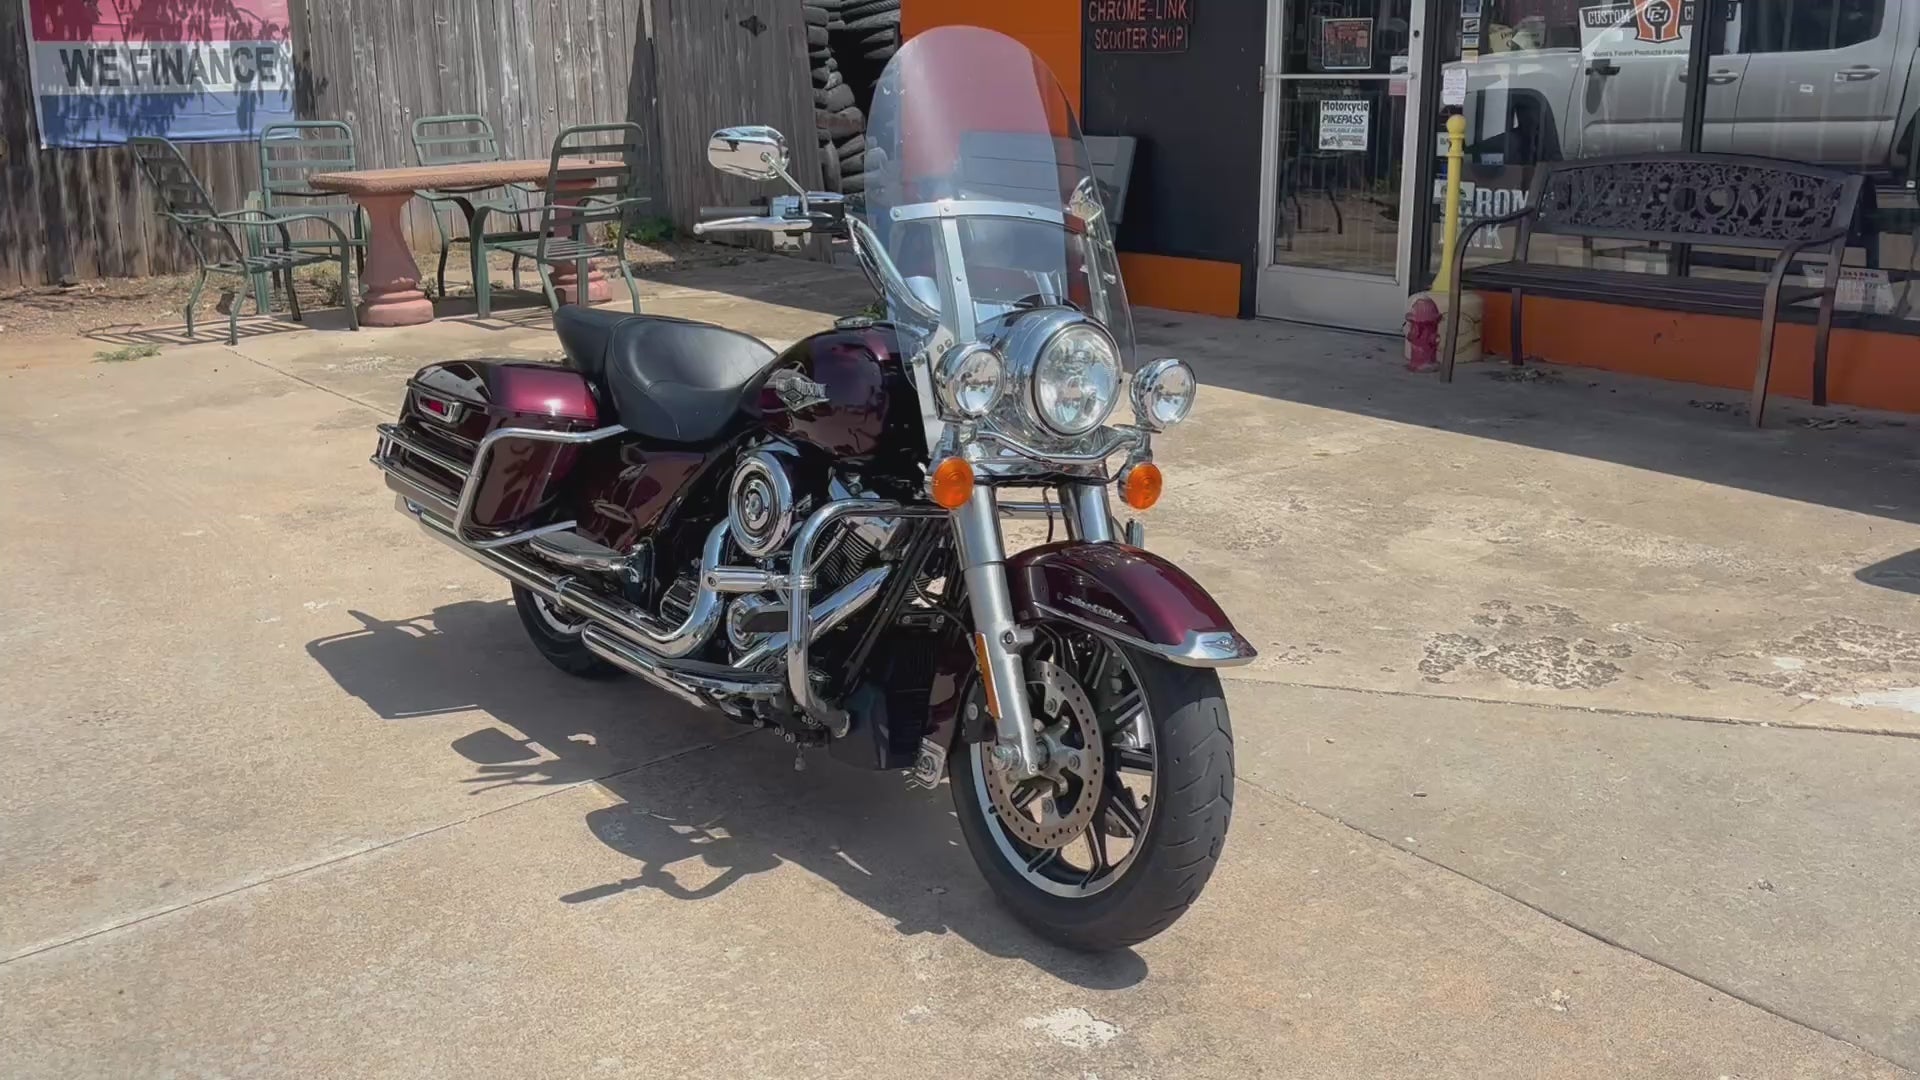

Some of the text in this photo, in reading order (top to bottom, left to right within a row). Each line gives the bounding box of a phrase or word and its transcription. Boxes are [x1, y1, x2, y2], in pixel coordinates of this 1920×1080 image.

[1088, 0, 1188, 21] CHROME-LINK
[1587, 8, 1631, 25] CUSTOM
[1094, 26, 1184, 49] SCOOTER SHOP
[60, 46, 276, 87] WE FINANCE
[1322, 101, 1369, 113] Motorcycle
[1322, 114, 1364, 124] PIKEPASS
